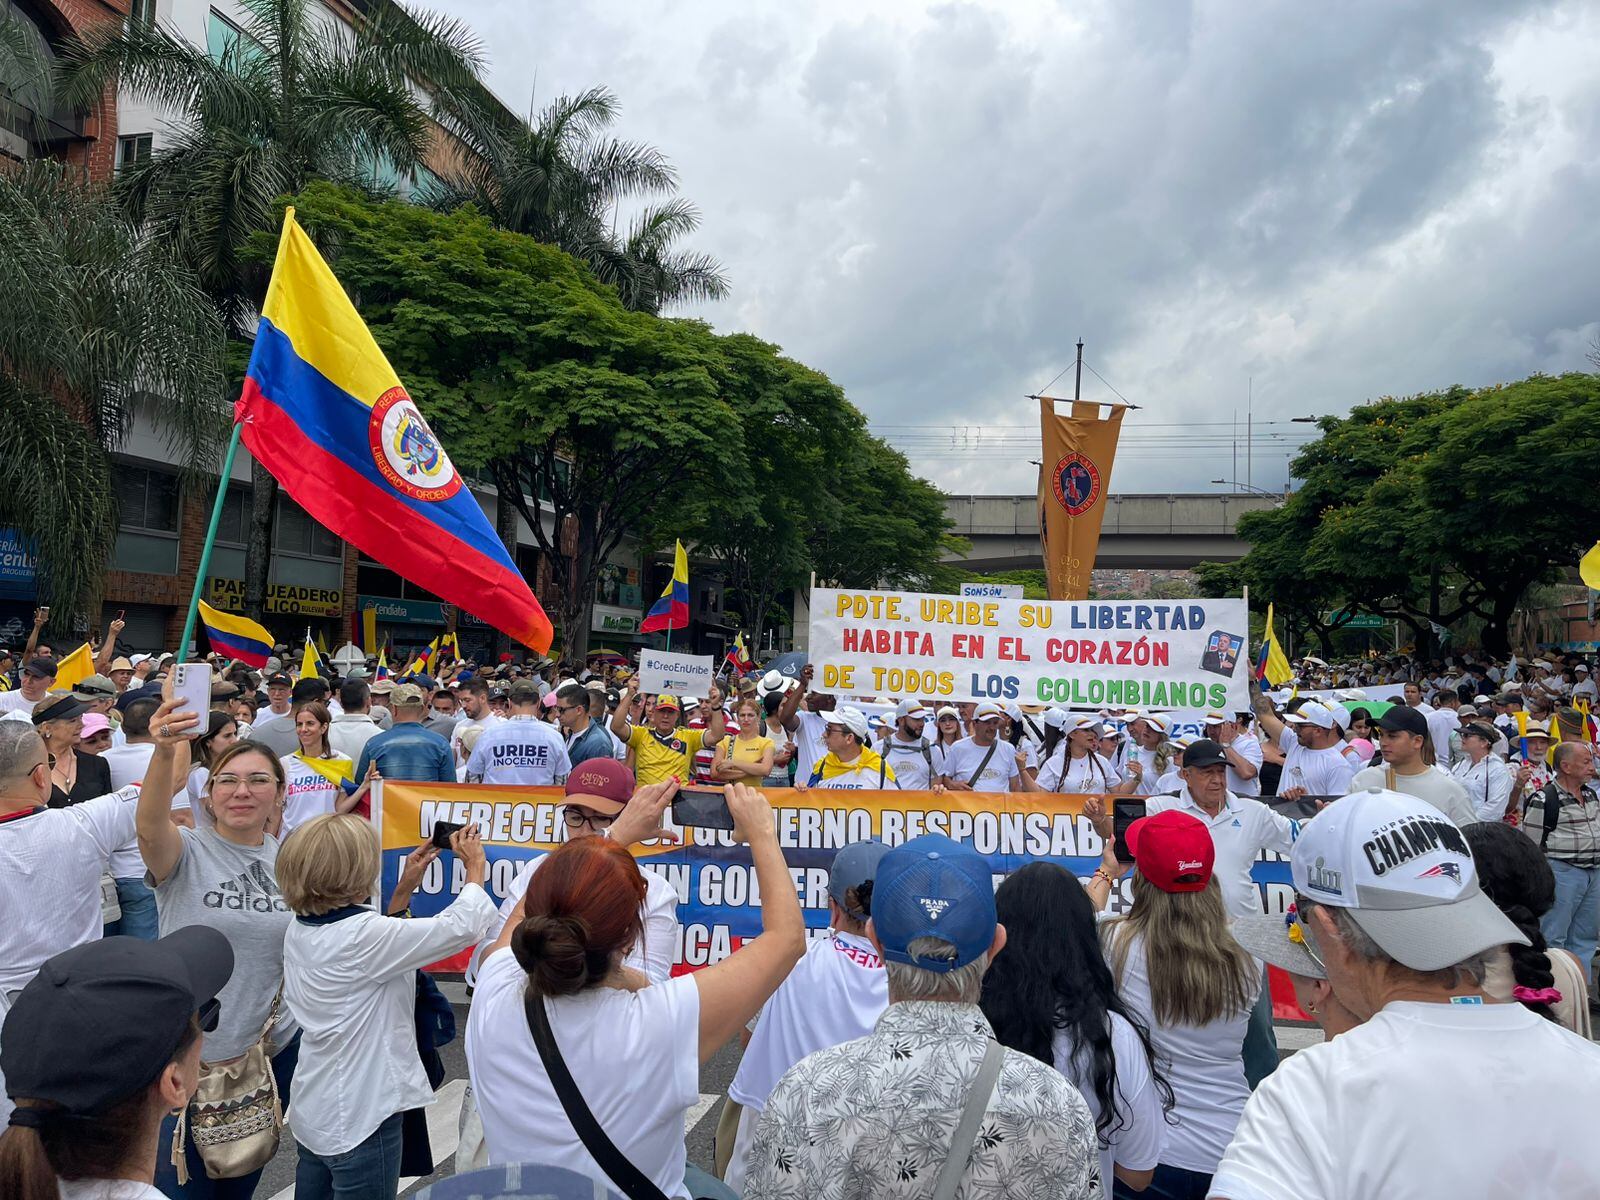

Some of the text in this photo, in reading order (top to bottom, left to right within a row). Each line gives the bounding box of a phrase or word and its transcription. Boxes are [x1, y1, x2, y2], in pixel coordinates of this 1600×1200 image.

[372, 446, 403, 487] LIBERTAD
[416, 489, 449, 500] ORDEN
[214, 578, 340, 603] PARUEADERO
[964, 586, 1002, 596] SONSÓN
[836, 594, 1206, 630] PDTE. URIBE SU LIBERTAD
[843, 628, 1169, 666] HABITA EN EL CORAZÓN
[647, 659, 709, 675] #CreoEnUribe
[824, 664, 1227, 708] DE TODOS LOS COLOMBIANOS
[493, 744, 548, 758] URIBE
[493, 757, 547, 767] INOCENTE
[881, 810, 1103, 857] RESPONSAB
[1372, 815, 1414, 836] SUPER
[203, 891, 292, 912] adida
[920, 898, 949, 907] PRADA
